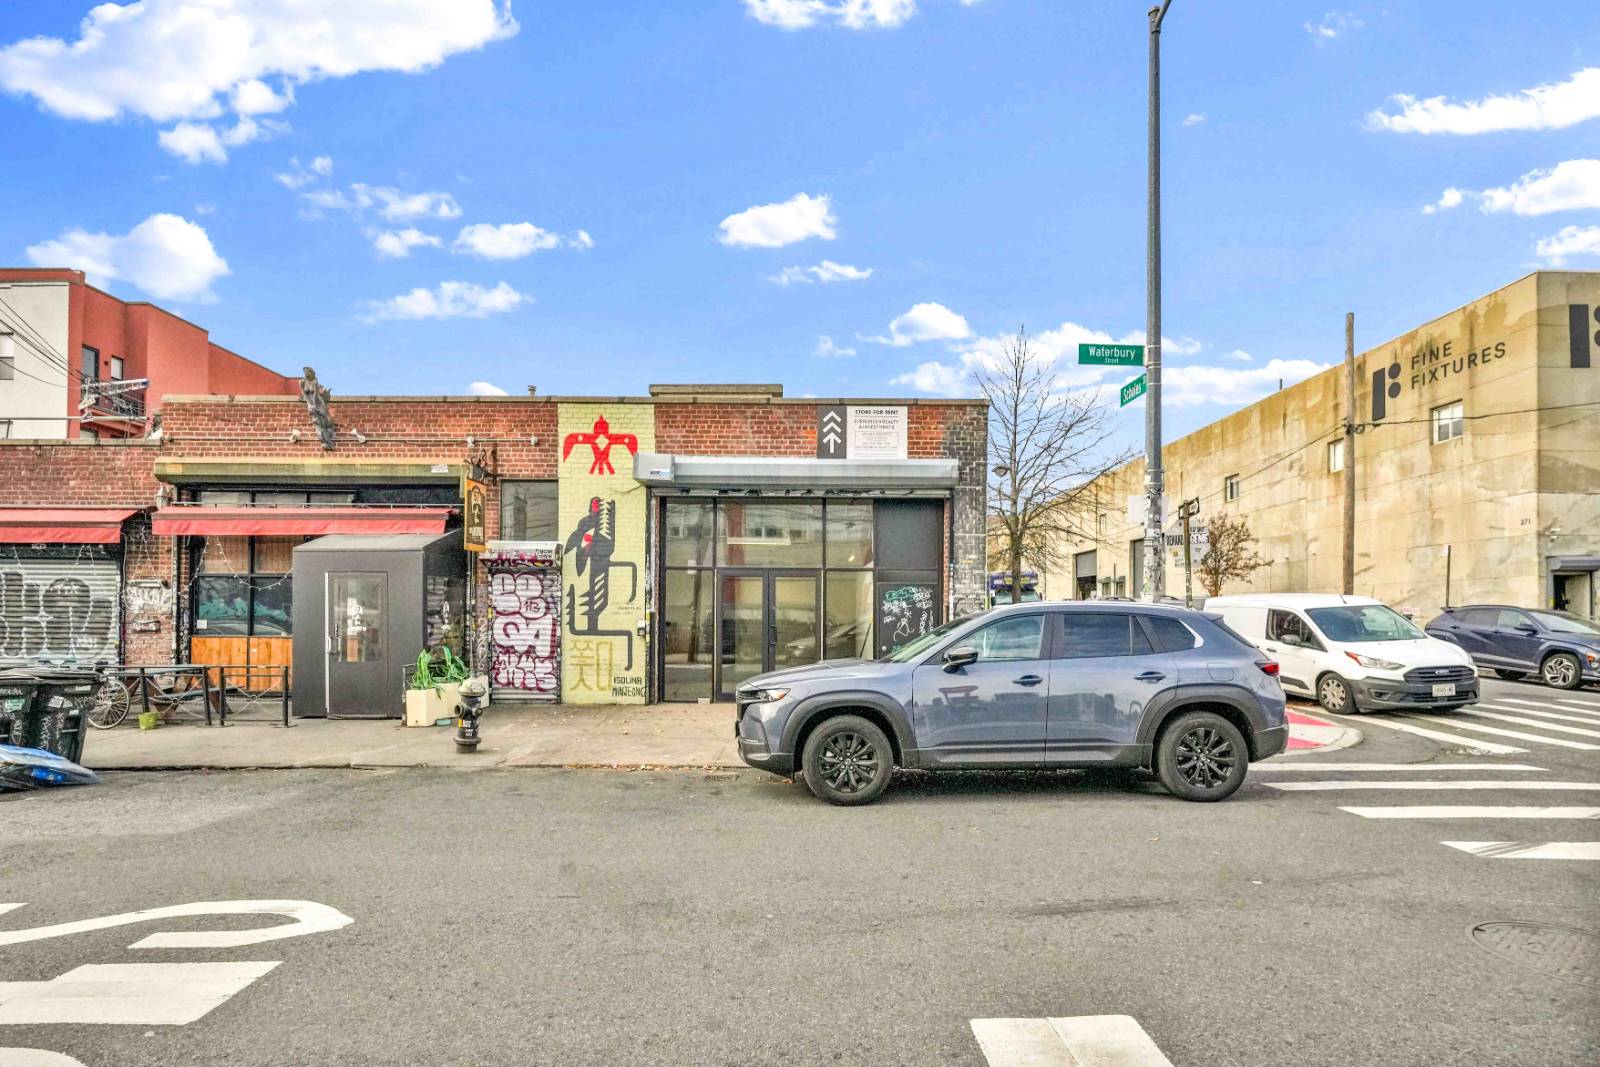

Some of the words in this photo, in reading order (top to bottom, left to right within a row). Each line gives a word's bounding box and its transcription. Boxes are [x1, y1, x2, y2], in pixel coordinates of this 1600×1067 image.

[1088, 345, 1136, 360] Waterbury
[1411, 341, 1453, 370] FINE
[1411, 341, 1506, 390] FIXTURES
